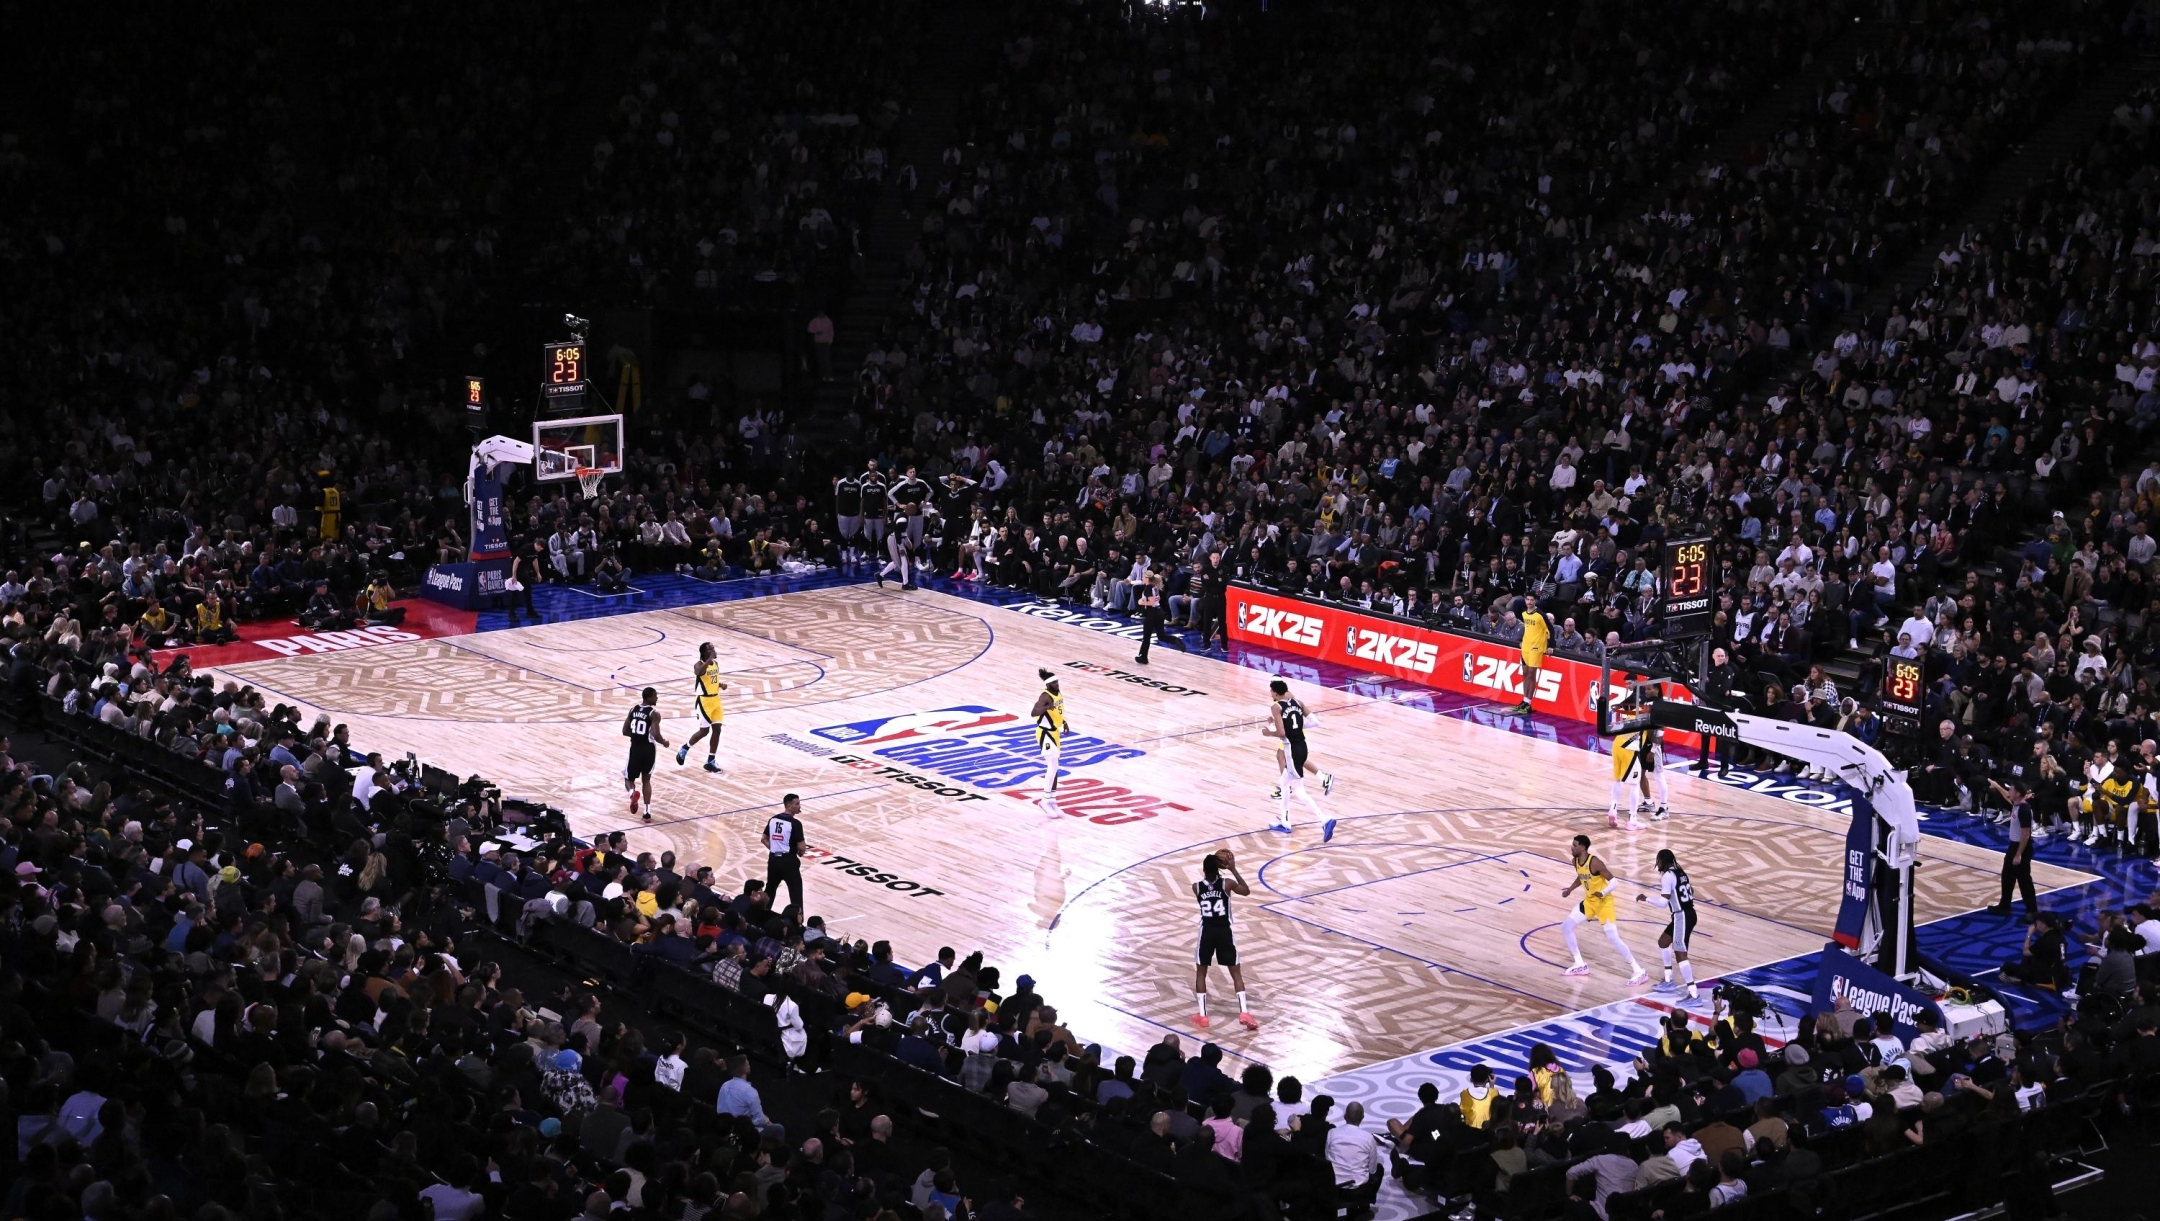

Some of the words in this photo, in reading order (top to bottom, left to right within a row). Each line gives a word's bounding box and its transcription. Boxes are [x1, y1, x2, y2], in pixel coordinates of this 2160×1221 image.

[557, 348, 579, 361] 6:05
[553, 361, 577, 382] 23
[470, 391, 480, 402] 23
[558, 384, 584, 393] TISSOT
[484, 541, 508, 550] TISSOT
[1678, 544, 1705, 564] 6:05
[486, 570, 502, 580] PARIS
[1673, 564, 1701, 595] 23
[1678, 599, 1709, 611] TISSOT
[1246, 604, 1324, 647] 2K25
[252, 625, 422, 656] PARIS
[1355, 628, 1439, 674] 2K25
[1896, 663, 1919, 681] 6:05
[1103, 670, 1208, 697] TISSOT
[1893, 677, 1914, 699] 23
[1893, 703, 1920, 715] TISSOT
[630, 718, 647, 735] 40
[1291, 713, 1299, 729] 1
[1695, 719, 1736, 739] Revolut
[873, 738, 1071, 789] GAMES
[873, 766, 989, 802] TISSOT
[1001, 778, 1194, 826] 2025
[775, 821, 784, 834] 15
[1849, 849, 1864, 867] GET
[820, 856, 945, 897] TISSOT
[1849, 865, 1863, 883] THE
[1200, 890, 1222, 900] VASSELL
[1852, 884, 1866, 902] App
[1200, 899, 1226, 917] 24
[1843, 978, 1890, 1018] League
